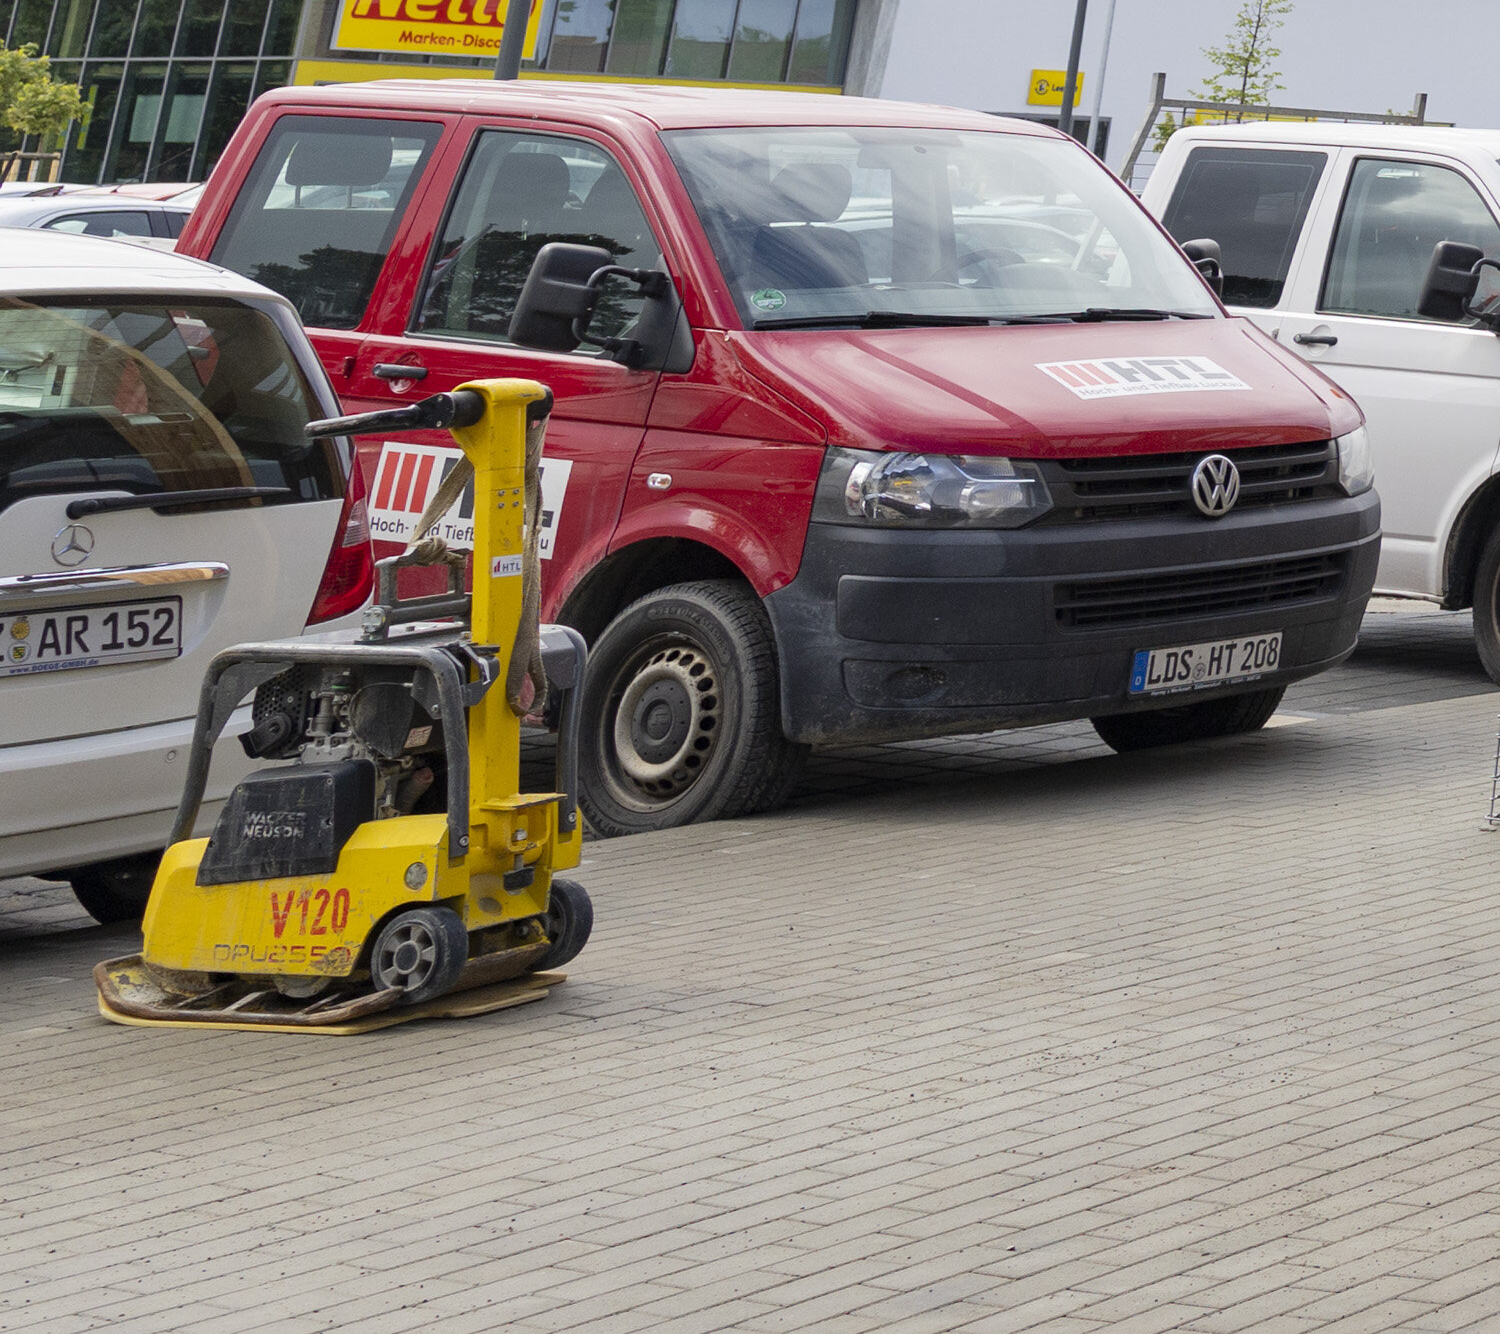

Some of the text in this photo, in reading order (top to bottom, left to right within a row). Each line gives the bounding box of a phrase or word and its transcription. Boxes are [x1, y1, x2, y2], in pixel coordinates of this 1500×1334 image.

[370, 517, 410, 534] Hoch-
[37, 616, 90, 658] AR
[101, 607, 175, 651] 152
[1147, 649, 1194, 685] LDS
[1207, 643, 1237, 677] HT
[1240, 636, 1280, 672] 208
[271, 888, 350, 939] V120
